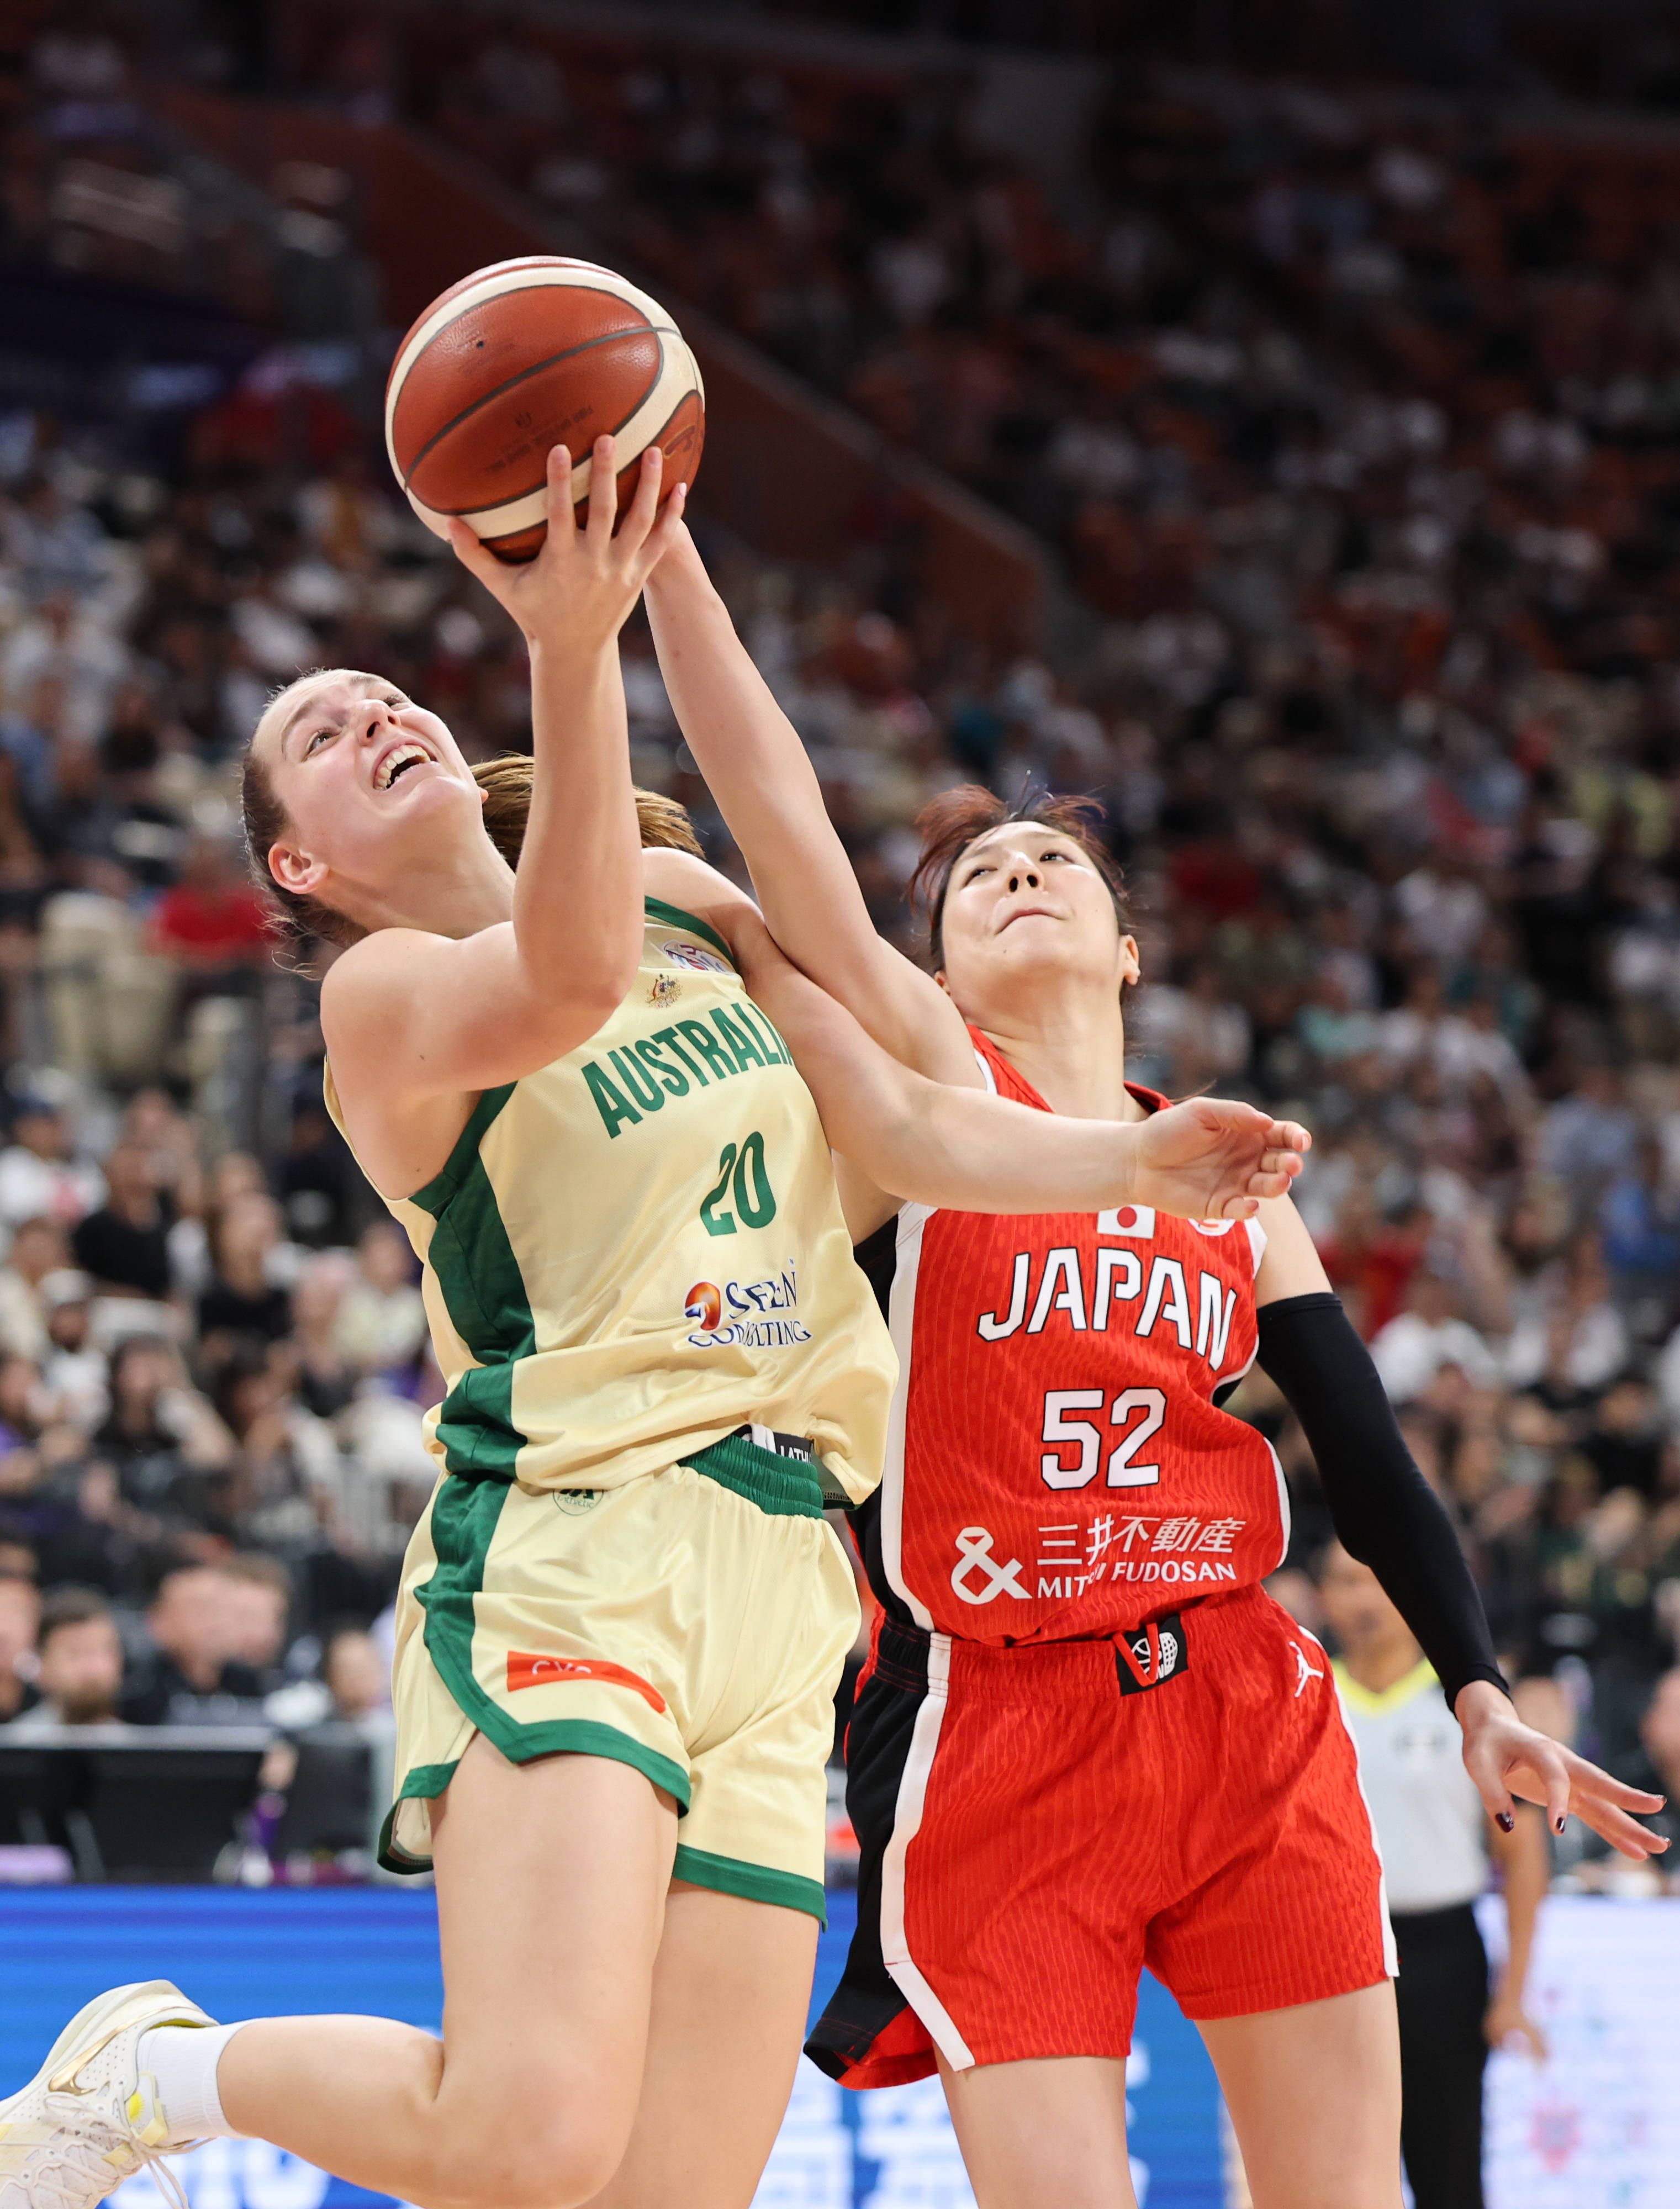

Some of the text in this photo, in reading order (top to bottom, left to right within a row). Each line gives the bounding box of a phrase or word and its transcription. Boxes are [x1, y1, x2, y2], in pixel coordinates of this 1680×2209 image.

[581, 1002, 794, 1139] AUSTRALI
[700, 1131, 776, 1236] 20
[976, 1246, 1238, 1371] JAPAN
[1040, 1387, 1167, 1491] 52
[1037, 1514, 1246, 1566] 三井不動産
[1111, 1561, 1237, 1583] FUDOSAN
